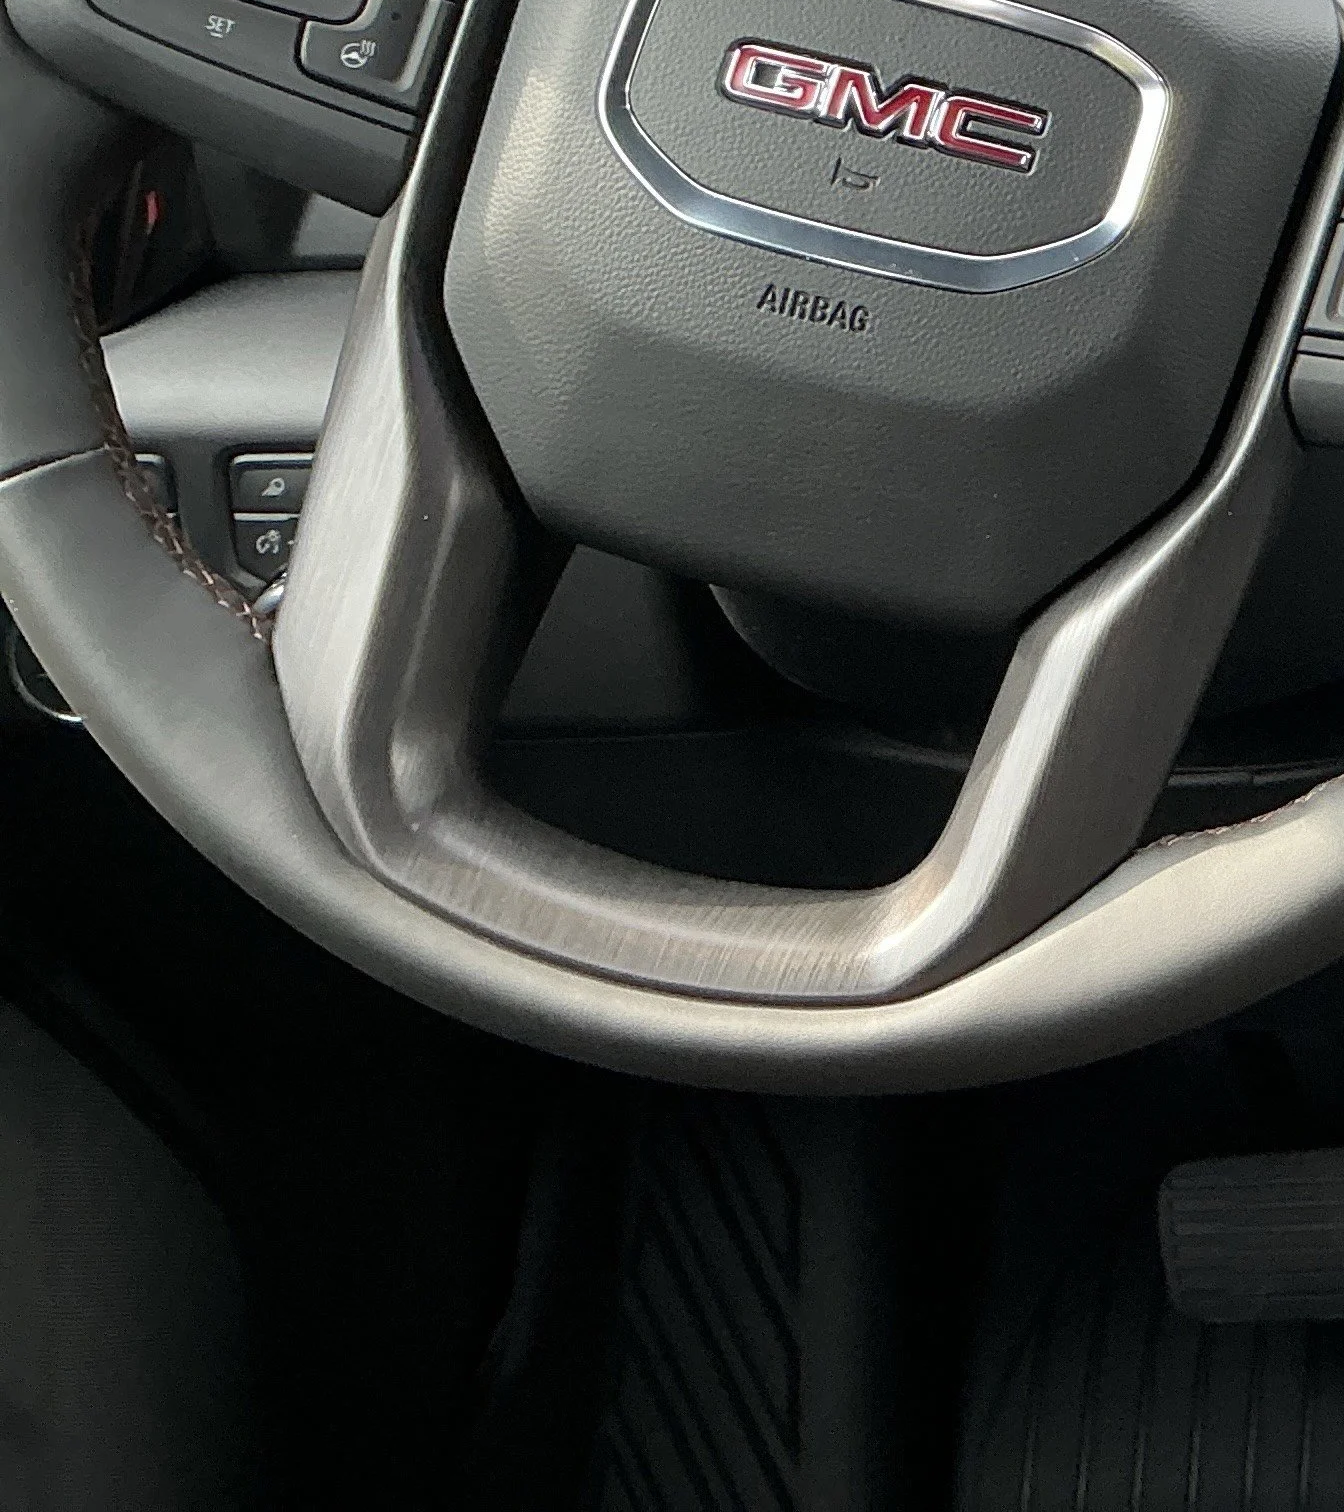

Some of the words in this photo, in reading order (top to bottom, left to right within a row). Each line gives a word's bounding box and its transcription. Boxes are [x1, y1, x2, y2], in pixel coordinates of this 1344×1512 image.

[205, 14, 236, 34] SET
[721, 37, 1053, 174] GMC
[756, 284, 872, 333] AIRBAG
